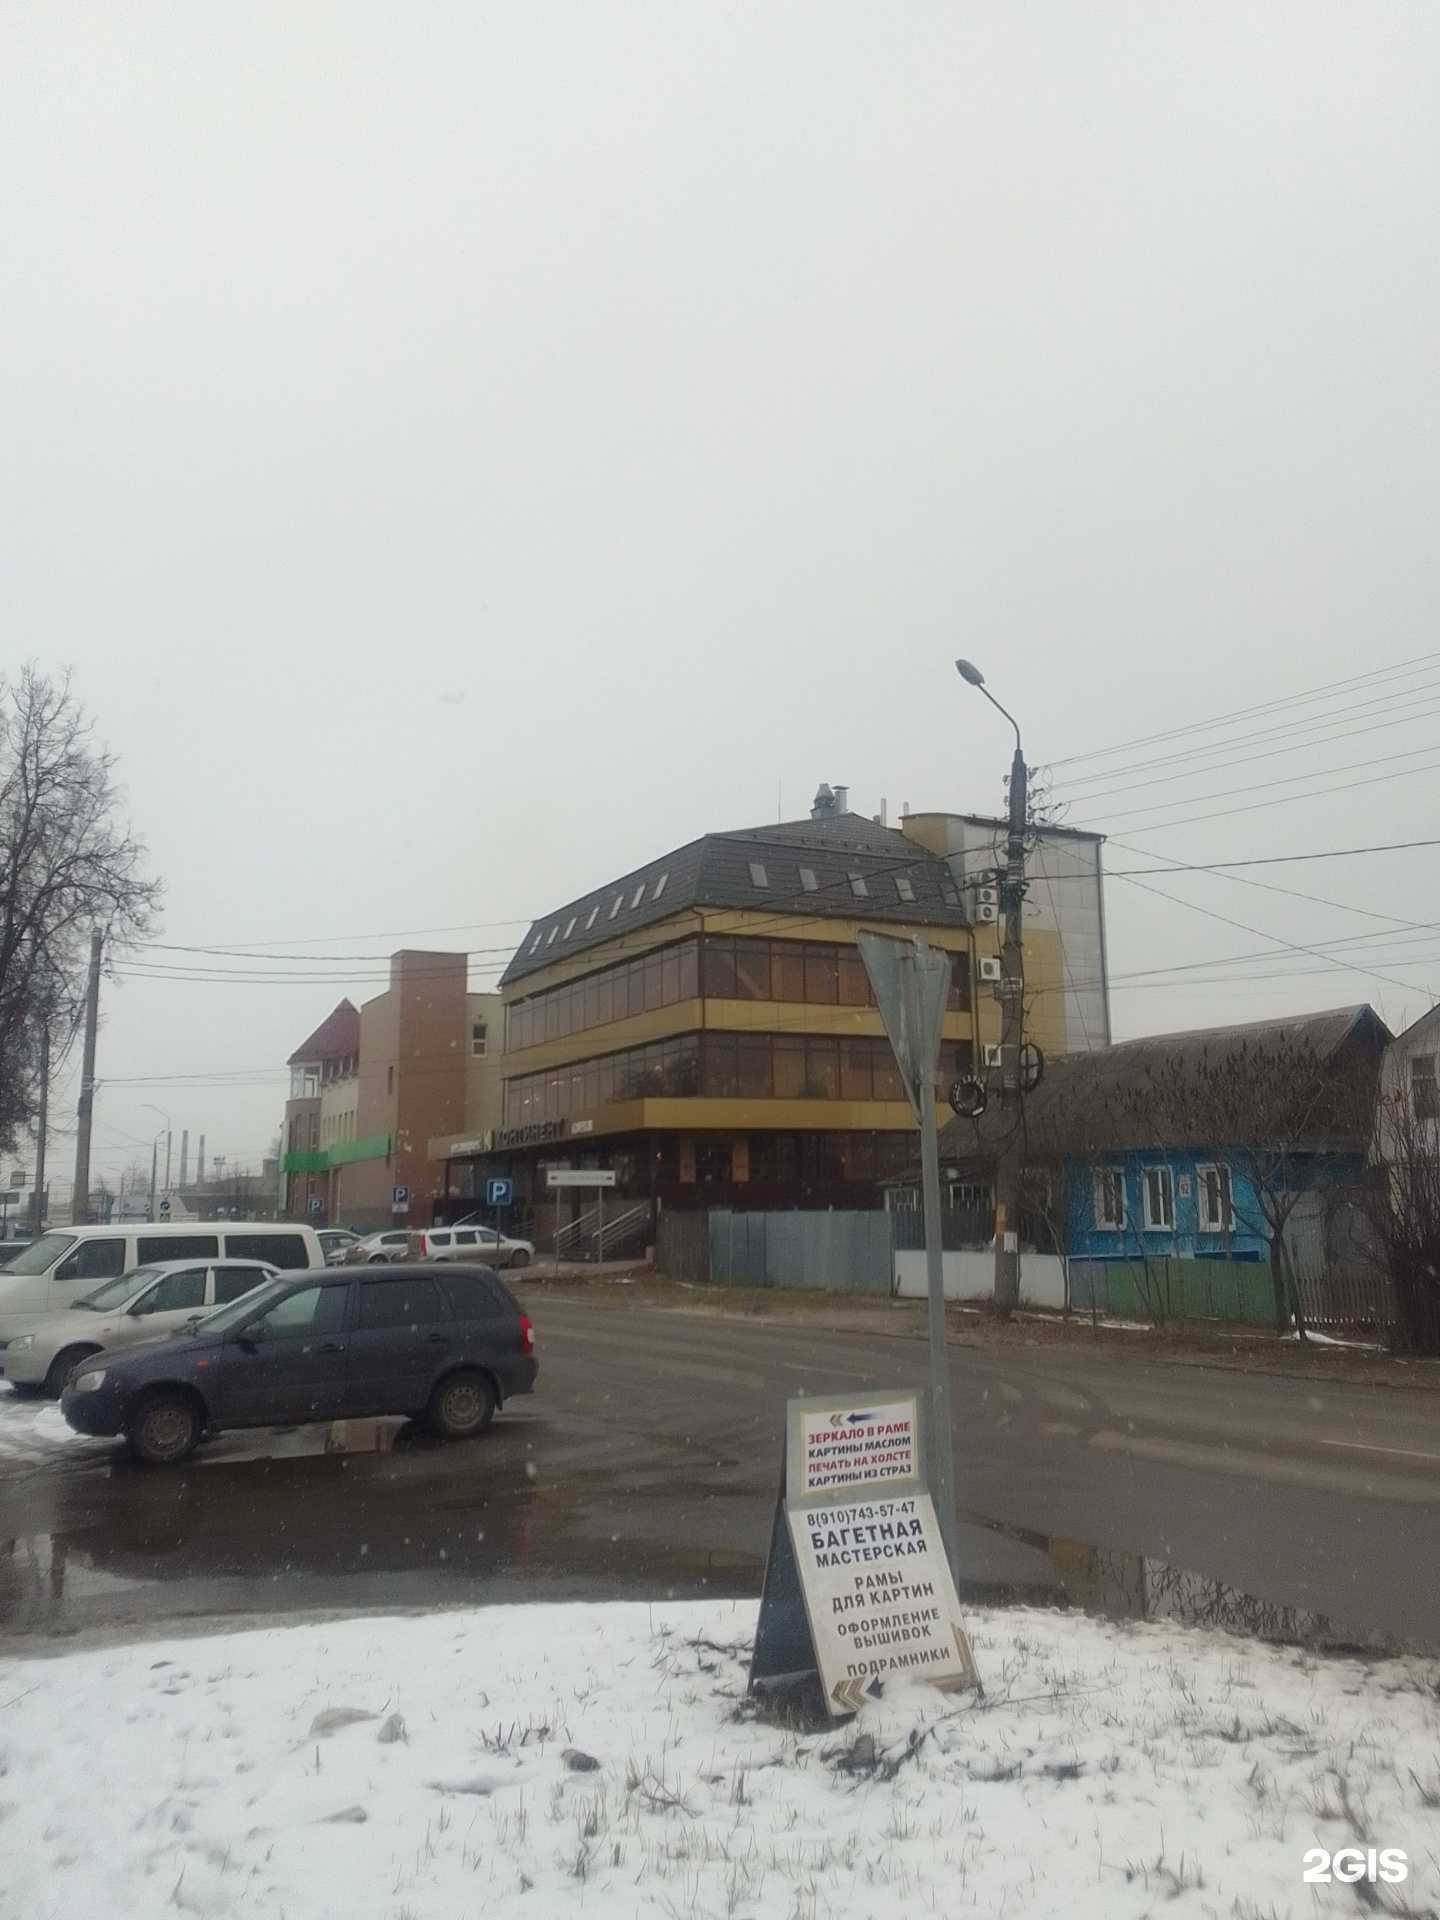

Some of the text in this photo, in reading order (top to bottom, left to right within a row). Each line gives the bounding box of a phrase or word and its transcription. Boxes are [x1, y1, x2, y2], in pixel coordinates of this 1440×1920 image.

[493, 1182, 506, 1202] P
[808, 1421, 911, 1445] ЗЕРКАЛО В РАМЕ
[808, 1436, 911, 1459] КАРТИНЫ МАСЛОМ
[808, 1450, 912, 1473] ПЕЧАТЬ НА ХОЛСТЕ
[808, 1464, 912, 1488] КАРТИНЫ ИЗ СТРАЗ
[807, 1501, 915, 1528] 8(910)743-57-47
[811, 1519, 923, 1549] БАГЕТНАЯ
[815, 1540, 928, 1568] МАСТЕРСКАЯ
[855, 1570, 904, 1590] РАМЫ
[832, 1582, 934, 1614] ДЛЯ КАРТИН
[838, 1608, 941, 1637] ОФОРМЛЕНИЕ
[854, 1625, 932, 1650] ВЫШИВОК
[847, 1647, 951, 1677] ПОДРАМНИКИ
